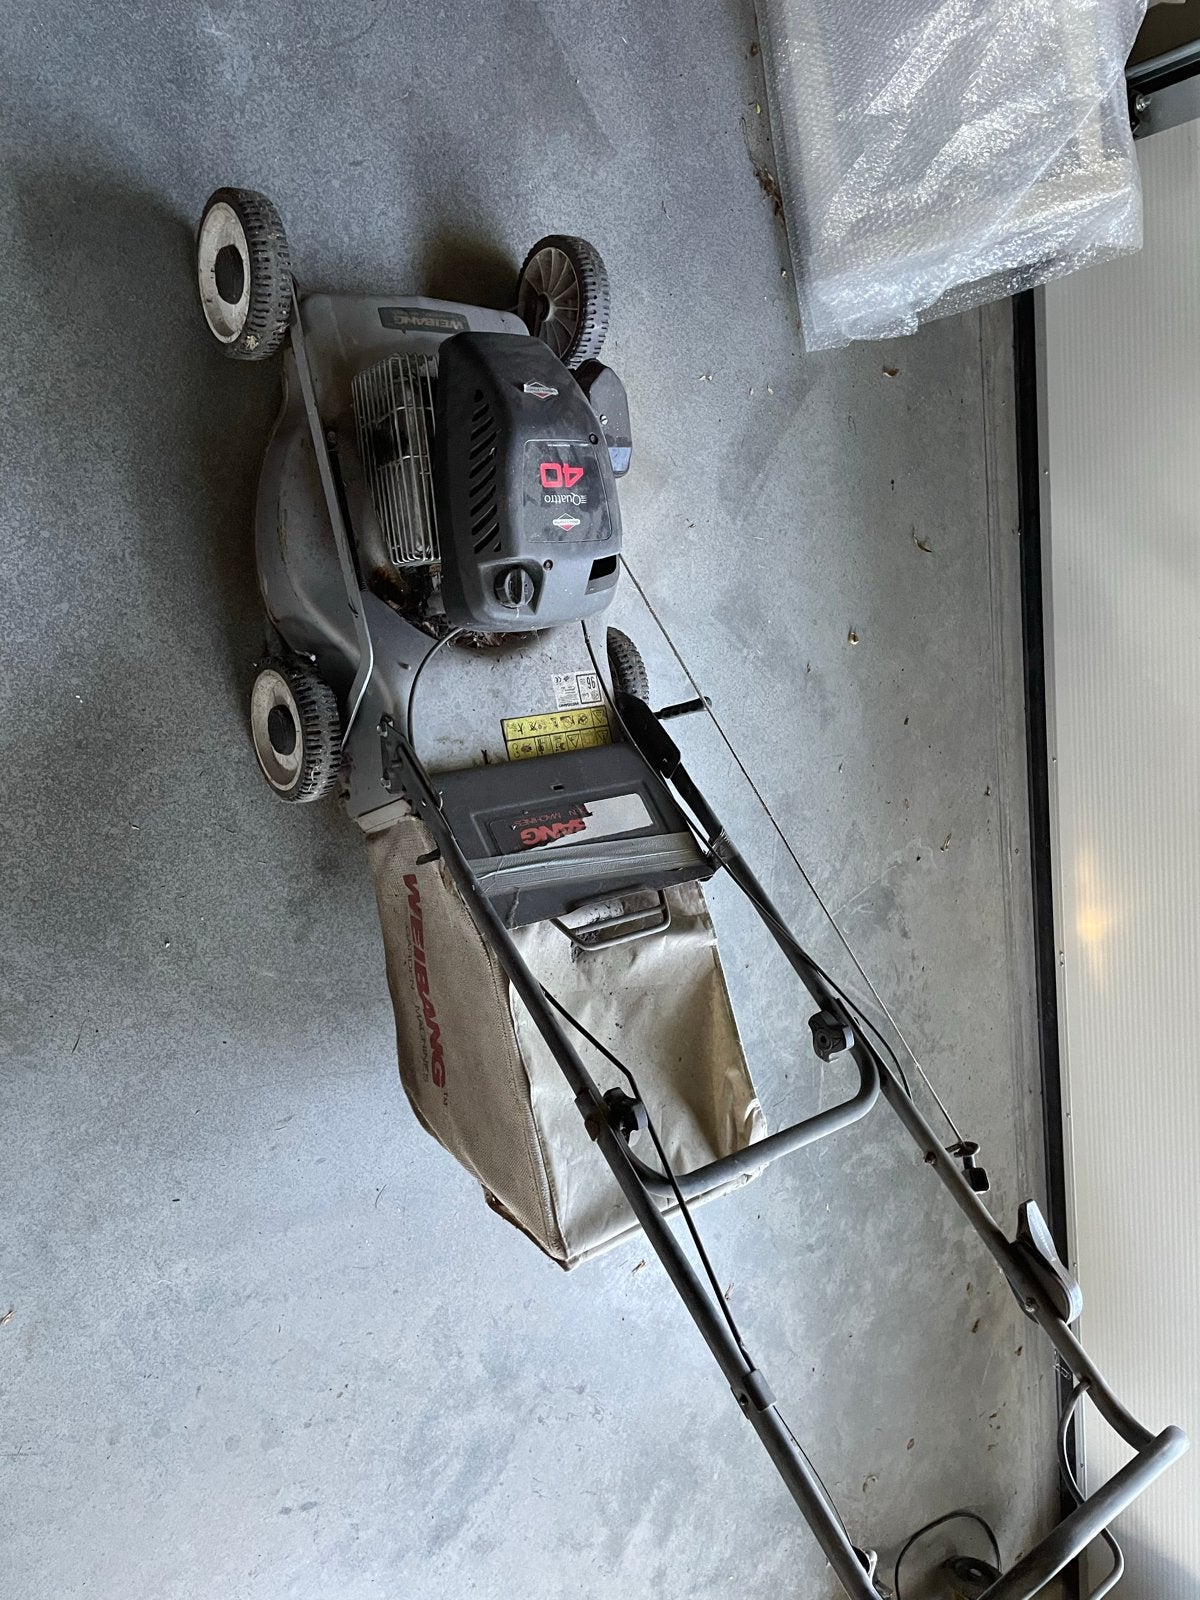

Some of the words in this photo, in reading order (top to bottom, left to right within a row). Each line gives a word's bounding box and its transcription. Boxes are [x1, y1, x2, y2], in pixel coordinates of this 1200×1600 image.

[393, 315, 465, 330] WEIBANG
[539, 462, 584, 488] 40
[544, 492, 582, 505] Quattro
[586, 675, 596, 689] 96
[402, 873, 446, 1088] WEIBANG
[404, 925, 416, 991] GARDEN
[414, 1004, 431, 1083] MACHINES
